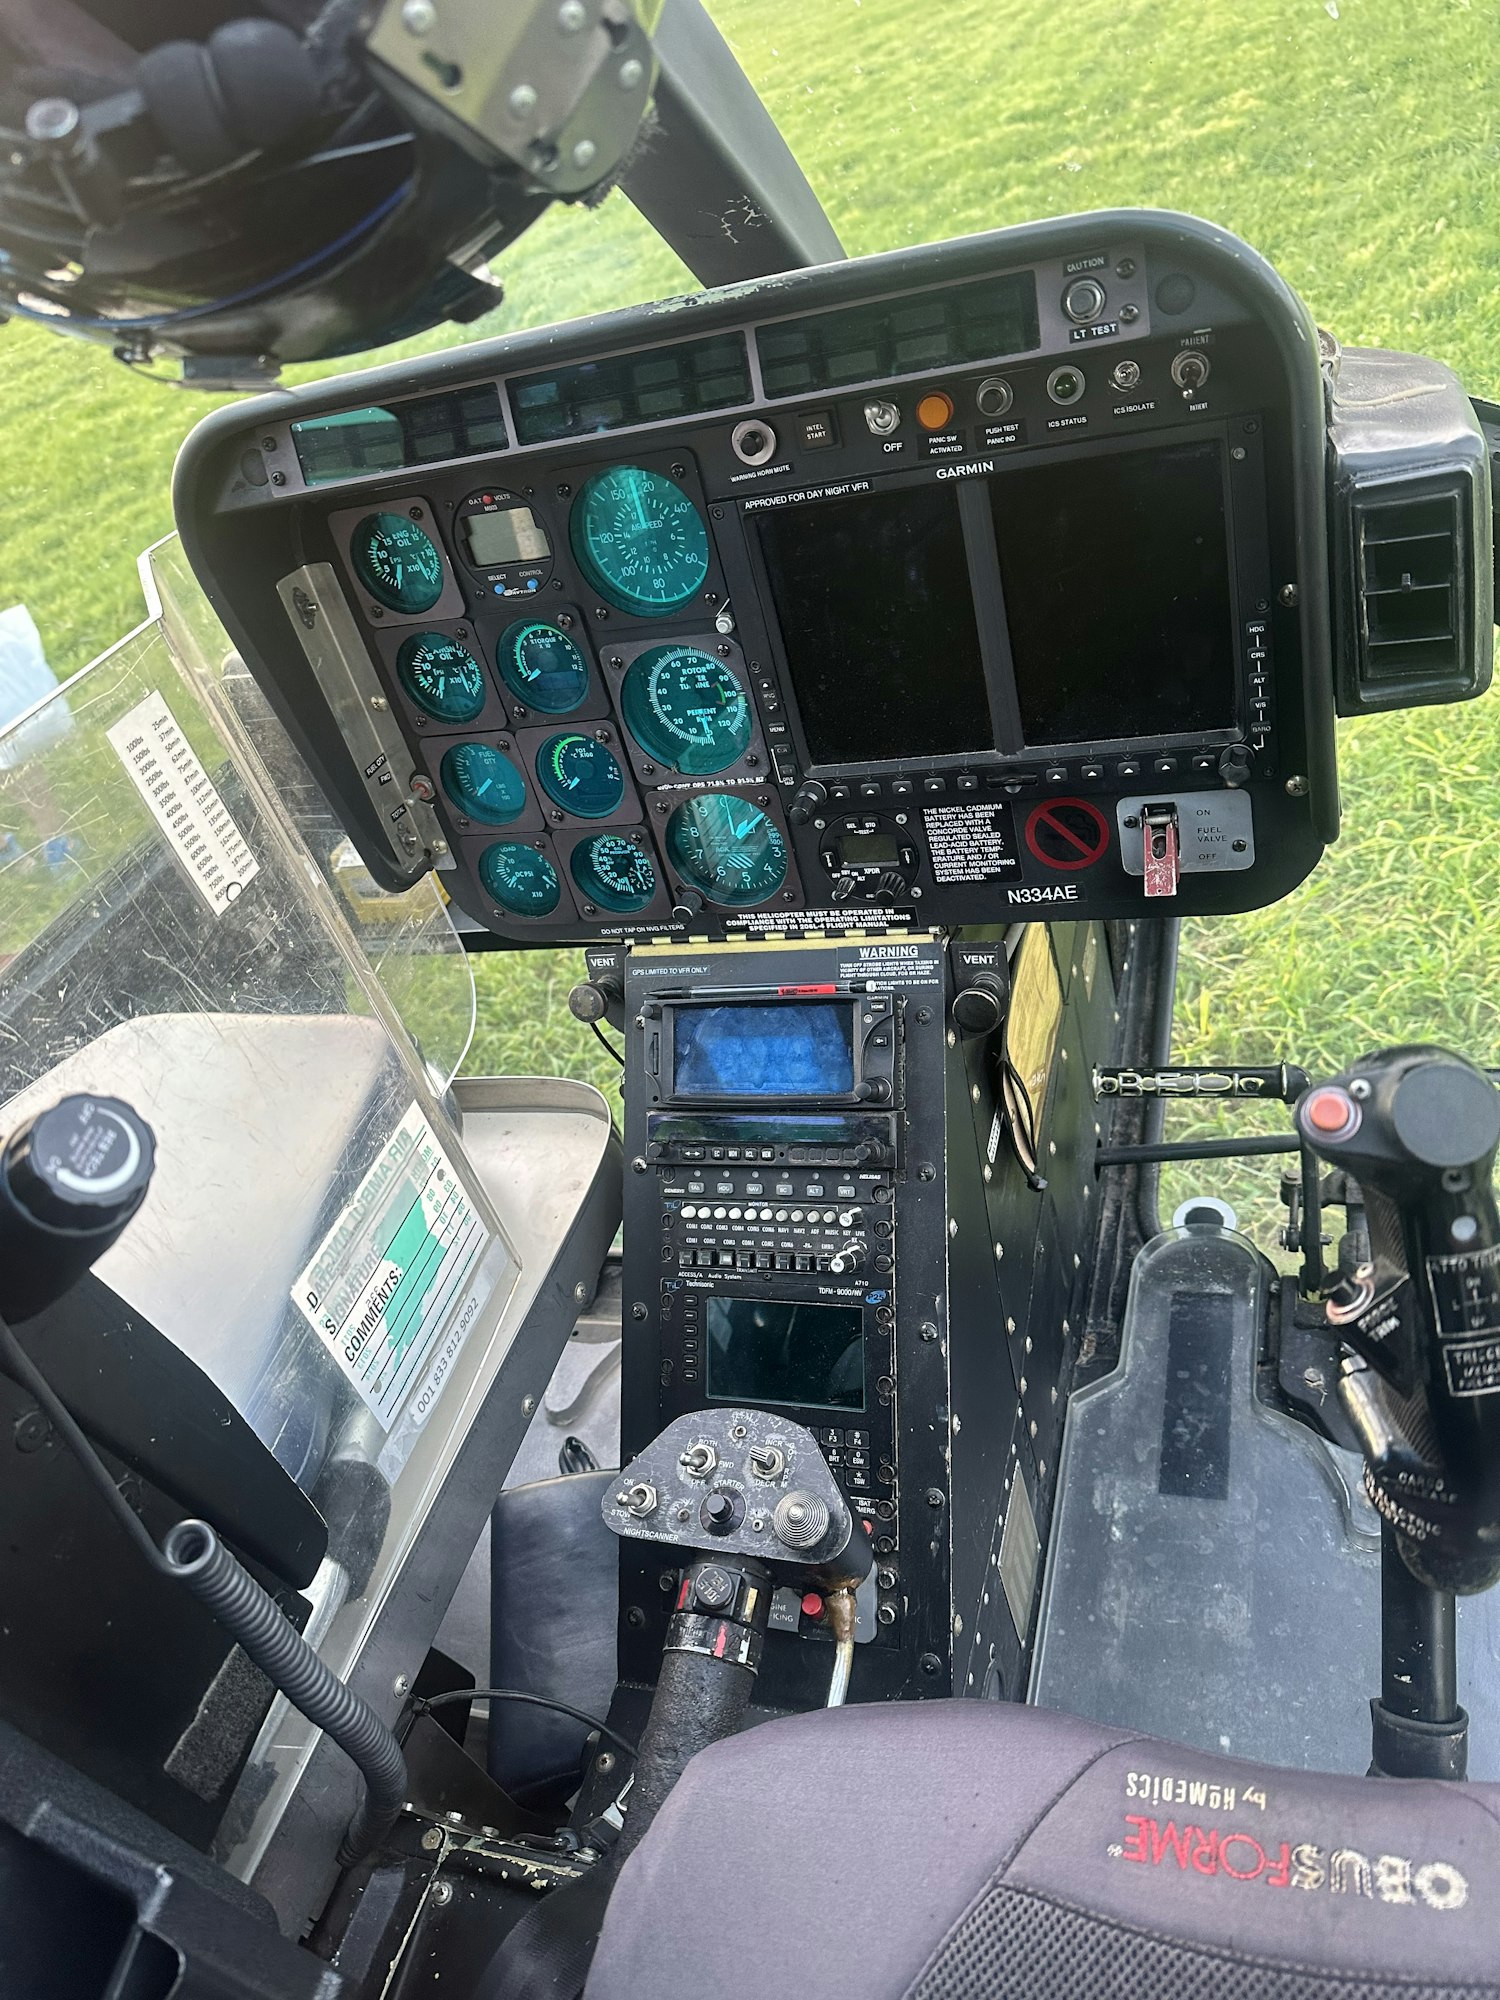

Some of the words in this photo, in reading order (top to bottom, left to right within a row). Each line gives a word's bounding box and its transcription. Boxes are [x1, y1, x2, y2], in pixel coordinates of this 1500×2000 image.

[1067, 257, 1104, 272] CAUTION
[1073, 329, 1087, 340] LT
[1091, 324, 1117, 335] TEST
[1113, 406, 1125, 414] ICS
[1126, 401, 1155, 413] ISOLATE
[1048, 419, 1060, 428] ICS
[1061, 416, 1087, 427] STATUS
[806, 424, 824, 433] INTEL
[985, 426, 1002, 435] PUSH
[1002, 423, 1019, 432] TEST
[806, 431, 827, 440] START
[1005, 435, 1016, 443] IND
[884, 442, 903, 453] OFF
[929, 445, 963, 455] ACTIVATED
[730, 471, 757, 483] WARNING
[756, 467, 774, 478] HORN
[773, 464, 791, 475] MUTE
[936, 460, 995, 480] GARMIN
[641, 481, 655, 492] 20
[494, 494, 511, 502] VOLTS
[744, 495, 786, 510] APPROVED
[788, 492, 806, 502] FOR
[806, 489, 823, 500] DAY
[825, 484, 850, 497] NIGHT
[850, 481, 869, 492] VFR
[674, 502, 688, 513] 40
[600, 533, 614, 544] 120
[685, 553, 698, 564] 60
[518, 569, 544, 577] CONTROL
[621, 566, 636, 577] 100
[652, 578, 665, 589] 80
[1249, 625, 1265, 633] HDG
[1250, 651, 1266, 659] CRS
[681, 667, 707, 676] ROTOR
[125, 735, 144, 753] 100lbs
[151, 715, 169, 731] 25min
[132, 746, 151, 765] 150lbs
[158, 726, 175, 743] 37min
[139, 757, 157, 776] 200lbs
[164, 737, 181, 753] 50min
[366, 764, 377, 776] FUEL
[376, 755, 386, 766] QTY
[151, 779, 170, 798] 300lbs
[177, 758, 194, 775] 75min
[380, 773, 391, 783] FWD
[391, 806, 406, 820] TOTAL
[699, 806, 708, 817] 9
[922, 807, 938, 815] THE
[938, 806, 966, 814] NICKEL
[965, 803, 1003, 812] CADMIUM
[1196, 809, 1211, 817] ON
[924, 813, 957, 822] BATTERY
[957, 812, 974, 820] HAS
[974, 811, 995, 819] BEEN
[925, 820, 964, 829] REPLACED
[177, 822, 195, 841] 500lbs
[690, 826, 700, 837] 8
[926, 826, 968, 836] CONCORDE
[968, 825, 993, 833] VALVE
[928, 833, 972, 843] REGULATED
[972, 831, 1001, 840] SEALED
[1197, 835, 1228, 843] VALVE
[929, 840, 968, 849] LEAD-ACID
[968, 838, 1005, 847] BATTERY.
[772, 847, 782, 858] 3
[930, 848, 946, 856] THE
[946, 846, 979, 855] BATTERY
[979, 845, 1004, 853] TEMP-
[932, 854, 966, 863] ERATURE
[966, 853, 982, 861] AND
[987, 852, 1000, 860] OR
[1198, 853, 1217, 861] OFF
[933, 861, 968, 870] CURRENT
[968, 858, 1016, 868] MONITORING
[716, 866, 726, 877] 6
[741, 871, 751, 882] 5
[864, 867, 881, 875] XPDR
[934, 868, 965, 876] SYSTEM
[964, 867, 981, 875] HAS
[981, 866, 1002, 874] BEEN
[208, 873, 225, 891] 750lbs
[936, 873, 987, 883] DEACTIVATED.
[1007, 884, 1079, 904] N334AE
[757, 911, 805, 920] HELICOPTER
[806, 910, 829, 918] MUST
[830, 909, 841, 917] BE
[842, 908, 884, 917] OPERATED
[725, 918, 775, 928] COMPLIANCE
[776, 917, 796, 925] WITH
[796, 916, 813, 924] THE
[814, 915, 860, 924] OPERATING
[860, 913, 912, 922] LIMITATIONS
[748, 923, 788, 932] SPECIFIED
[789, 923, 799, 931] IN
[799, 922, 825, 931] 206L-4
[826, 921, 855, 929] FLIGHT
[855, 920, 889, 929] MANUAL
[600, 927, 611, 935] DO
[624, 926, 637, 934] TAP
[637, 925, 647, 933] ON
[660, 923, 685, 931] FILTERS
[858, 945, 919, 958] WARNING
[589, 957, 616, 967] VENT
[962, 954, 995, 965] VENT
[632, 968, 645, 976] GPS
[644, 967, 668, 975] LIMITED
[668, 967, 678, 975] TO
[678, 966, 691, 974] VFR
[691, 966, 708, 974] ONLY
[685, 1280, 715, 1288] Technisonic
[343, 1265, 404, 1364] COMMENTS:
[416, 1387, 436, 1414] 001
[432, 1363, 448, 1386] 833
[446, 1335, 461, 1360] 812
[458, 1296, 480, 1335] 9092
[698, 1438, 718, 1446] BOTH
[764, 1439, 783, 1447] INCR
[828, 1455, 840, 1463] BRT
[852, 1457, 865, 1465] ESW
[718, 1461, 735, 1469] FWD
[713, 1478, 746, 1492] STARTER
[623, 1527, 679, 1542] NIGHTSCANNER
[697, 1580, 721, 1603] IDLE
[1240, 1786, 1267, 1811] by
